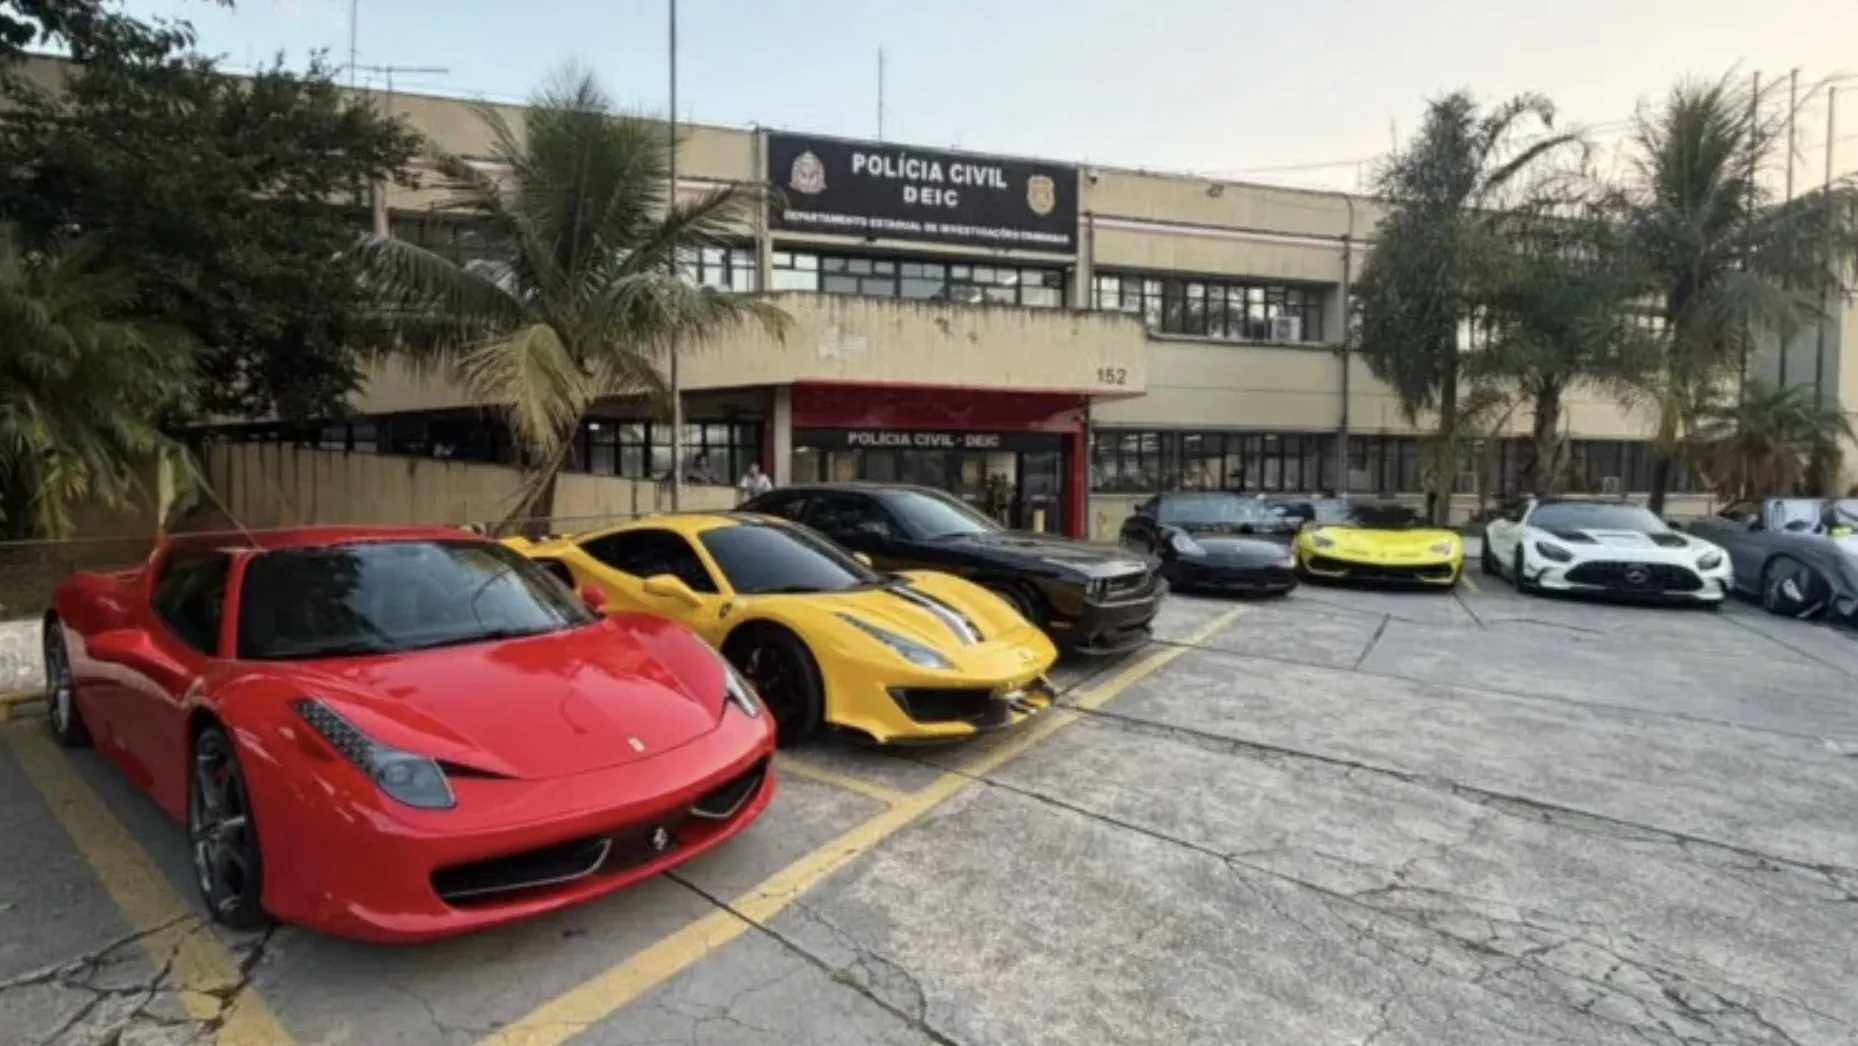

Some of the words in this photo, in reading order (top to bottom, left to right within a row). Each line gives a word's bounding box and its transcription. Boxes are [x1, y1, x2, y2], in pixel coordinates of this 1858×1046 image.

[852, 152, 944, 182] POLÍCIA
[950, 164, 1008, 189] CIVIL
[903, 186, 959, 207] DEIC
[783, 210, 867, 227] DEPARTAMENTO
[1096, 367, 1127, 385] 152
[914, 432, 954, 447] CIVIL
[965, 433, 1000, 448] DEIC
